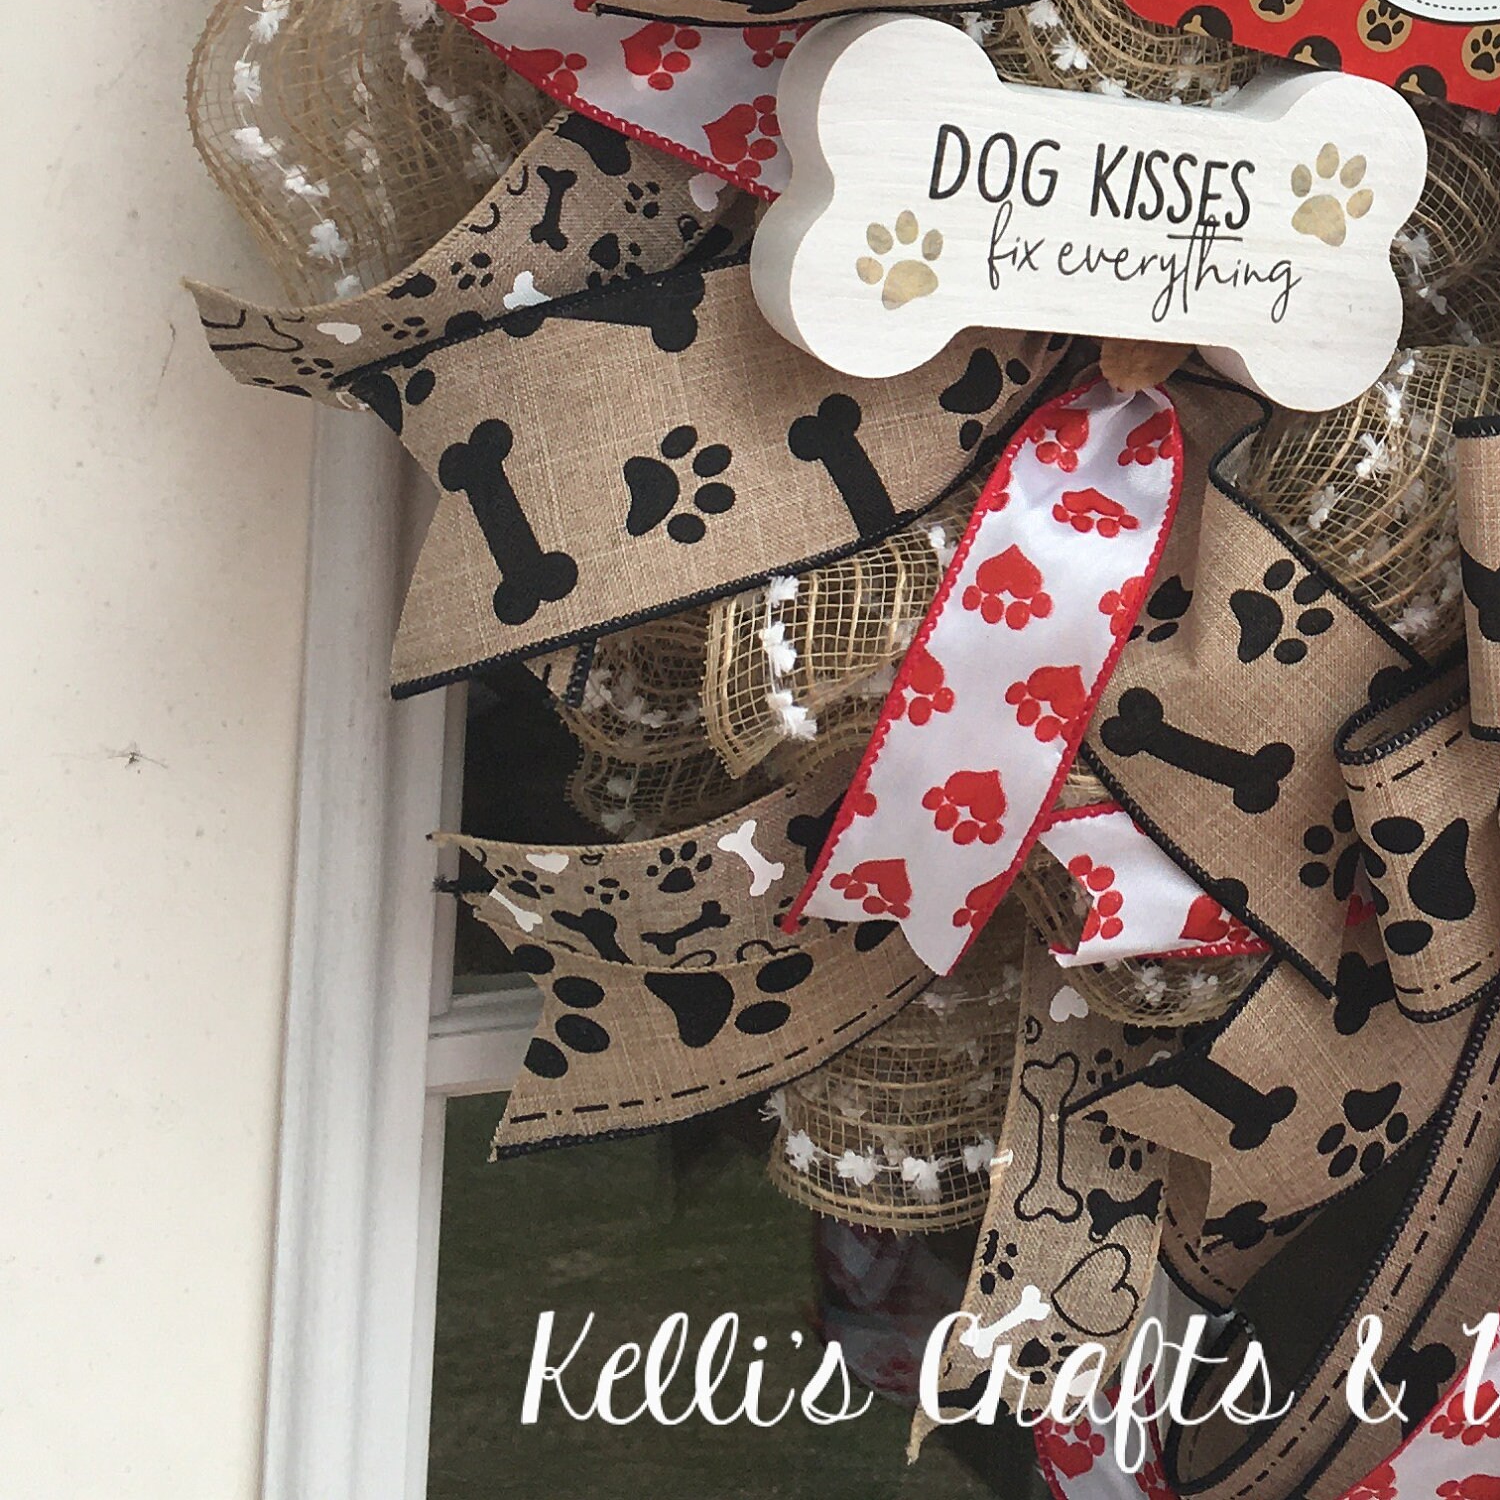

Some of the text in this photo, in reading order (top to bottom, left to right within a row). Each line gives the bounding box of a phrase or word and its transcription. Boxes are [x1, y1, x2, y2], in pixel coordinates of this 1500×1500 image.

[929, 124, 1255, 230] DOG KISSES
[988, 201, 1302, 322] fix everything
